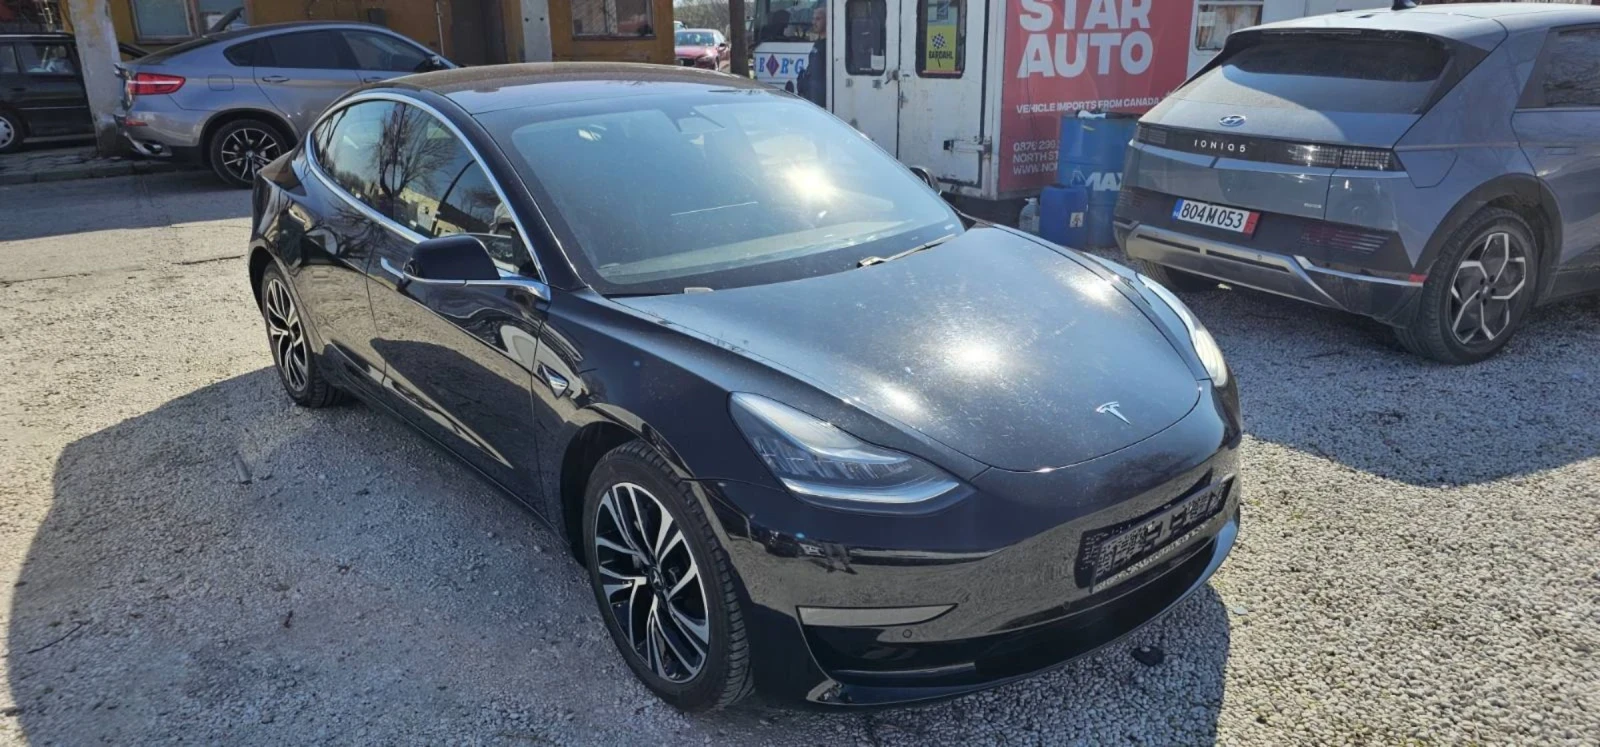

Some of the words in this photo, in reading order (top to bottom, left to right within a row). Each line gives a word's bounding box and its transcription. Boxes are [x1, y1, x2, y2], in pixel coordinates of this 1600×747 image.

[1019, 0, 1152, 32] STAR
[1016, 30, 1154, 79] AUTO
[1016, 102, 1056, 114] VEHICLE
[1056, 100, 1097, 112] IMPORTS
[1097, 98, 1123, 110] FROM
[1123, 96, 1160, 106] CANADA
[1194, 139, 1235, 152] IONIQ
[1239, 144, 1246, 153] 5
[1013, 152, 1047, 163] NORTH
